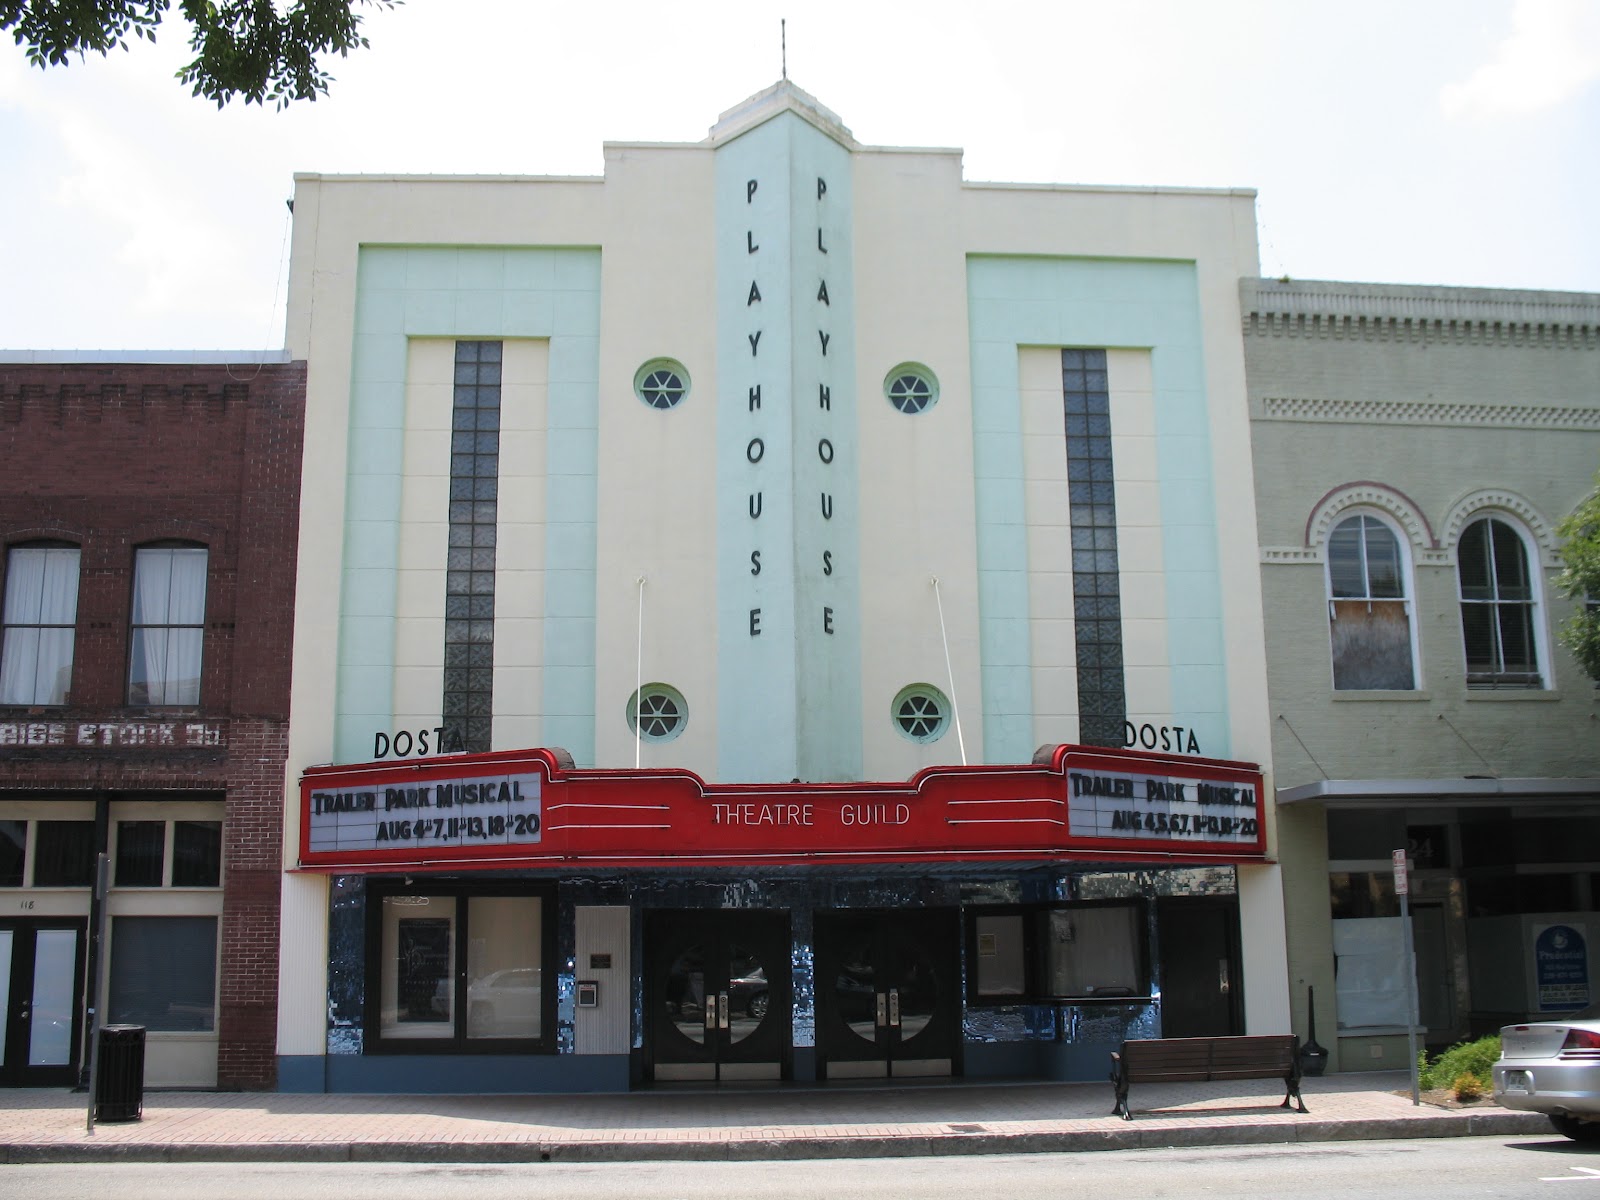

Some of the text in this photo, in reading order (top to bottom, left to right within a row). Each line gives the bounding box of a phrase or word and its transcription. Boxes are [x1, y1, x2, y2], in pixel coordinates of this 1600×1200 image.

[746, 178, 765, 637] PLAYHOUSE
[817, 176, 835, 635] PLAYHOUSE
[374, 727, 467, 759] DOSTA
[1125, 720, 1201, 754] DOSTA
[312, 780, 525, 816] TRAILER PARK MUSICAL
[1069, 772, 1256, 808] TRAILER PARK MUSICAL
[377, 820, 411, 841] AUG
[712, 803, 910, 826] THEATRE GUILD
[1112, 810, 1142, 830] AUG
[20, 900, 35, 910] 118
